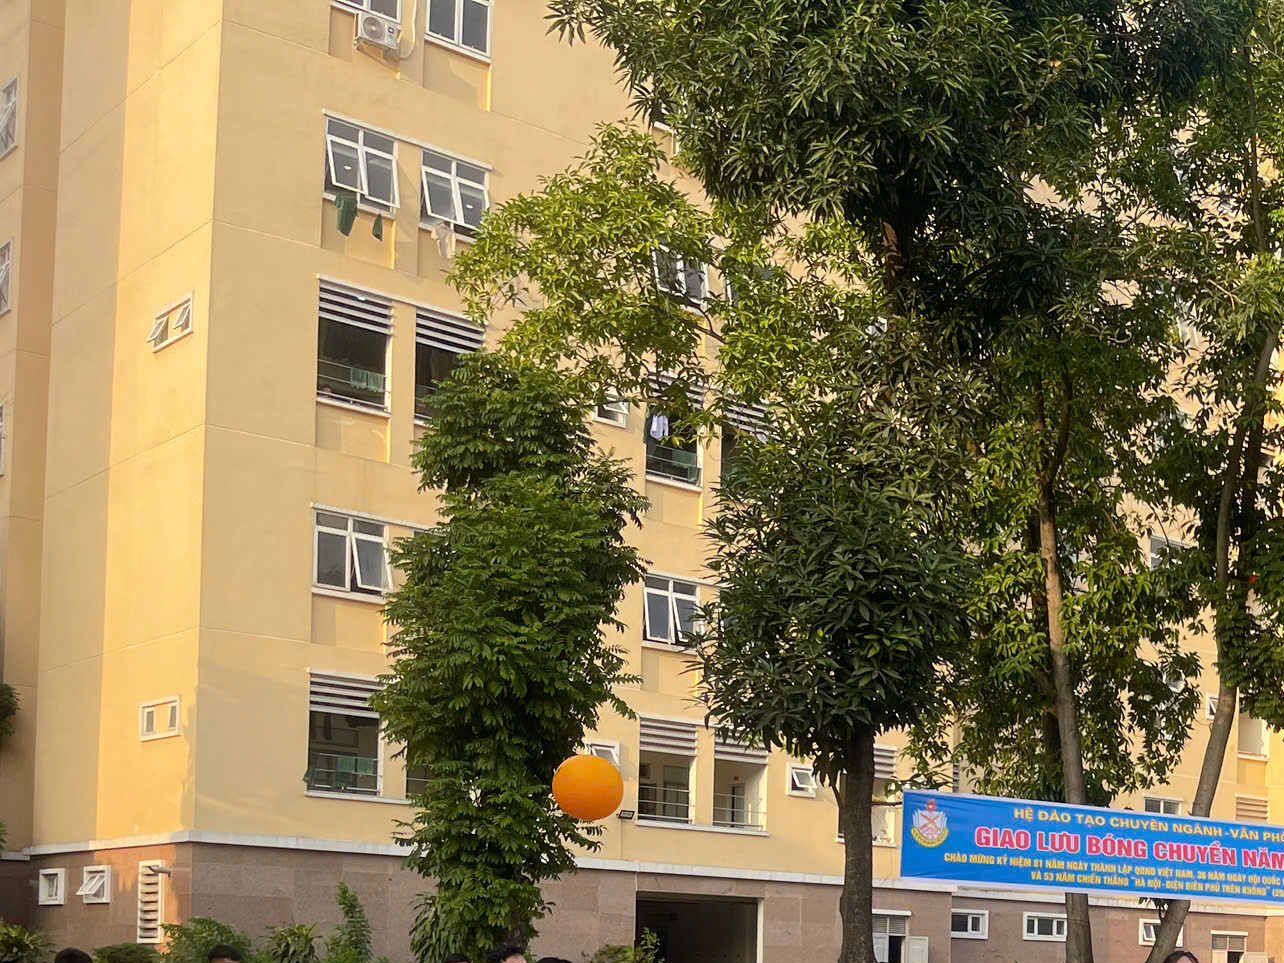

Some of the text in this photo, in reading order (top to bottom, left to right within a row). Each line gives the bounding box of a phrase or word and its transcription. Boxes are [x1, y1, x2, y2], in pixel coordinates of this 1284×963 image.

[1014, 807, 1033, 822] HỆ
[1038, 809, 1071, 822] ĐÀO
[1075, 814, 1105, 827] TẠO
[1110, 817, 1168, 832] CHUYÊN
[976, 827, 1030, 850] GIAO
[1037, 831, 1080, 853] LƯU
[1087, 833, 1148, 859] BÓNG
[1154, 841, 1237, 866] CHUYỀN
[944, 852, 967, 862] CHÀO
[969, 854, 994, 864] MỪNG
[1010, 857, 1031, 867] NIỆM
[1045, 858, 1064, 868] NĂM
[1067, 861, 1088, 870] NGÀY
[1091, 863, 1115, 872] THÀNH
[1118, 864, 1132, 874] LẬP
[1158, 867, 1173, 877] VIỆT
[1227, 873, 1246, 882] NGÀY
[1248, 874, 1260, 884] HỘI
[1262, 875, 1280, 885] QUỐC
[1031, 870, 1041, 880] VÀ
[1044, 872, 1053, 880] 53
[1056, 872, 1074, 882] NĂM
[1077, 873, 1101, 884] CHIẾN
[1104, 874, 1128, 886] THẮNG
[1148, 879, 1161, 890] NỘI
[1186, 881, 1203, 891] BIÊN
[1222, 883, 1240, 894] TRÊN
